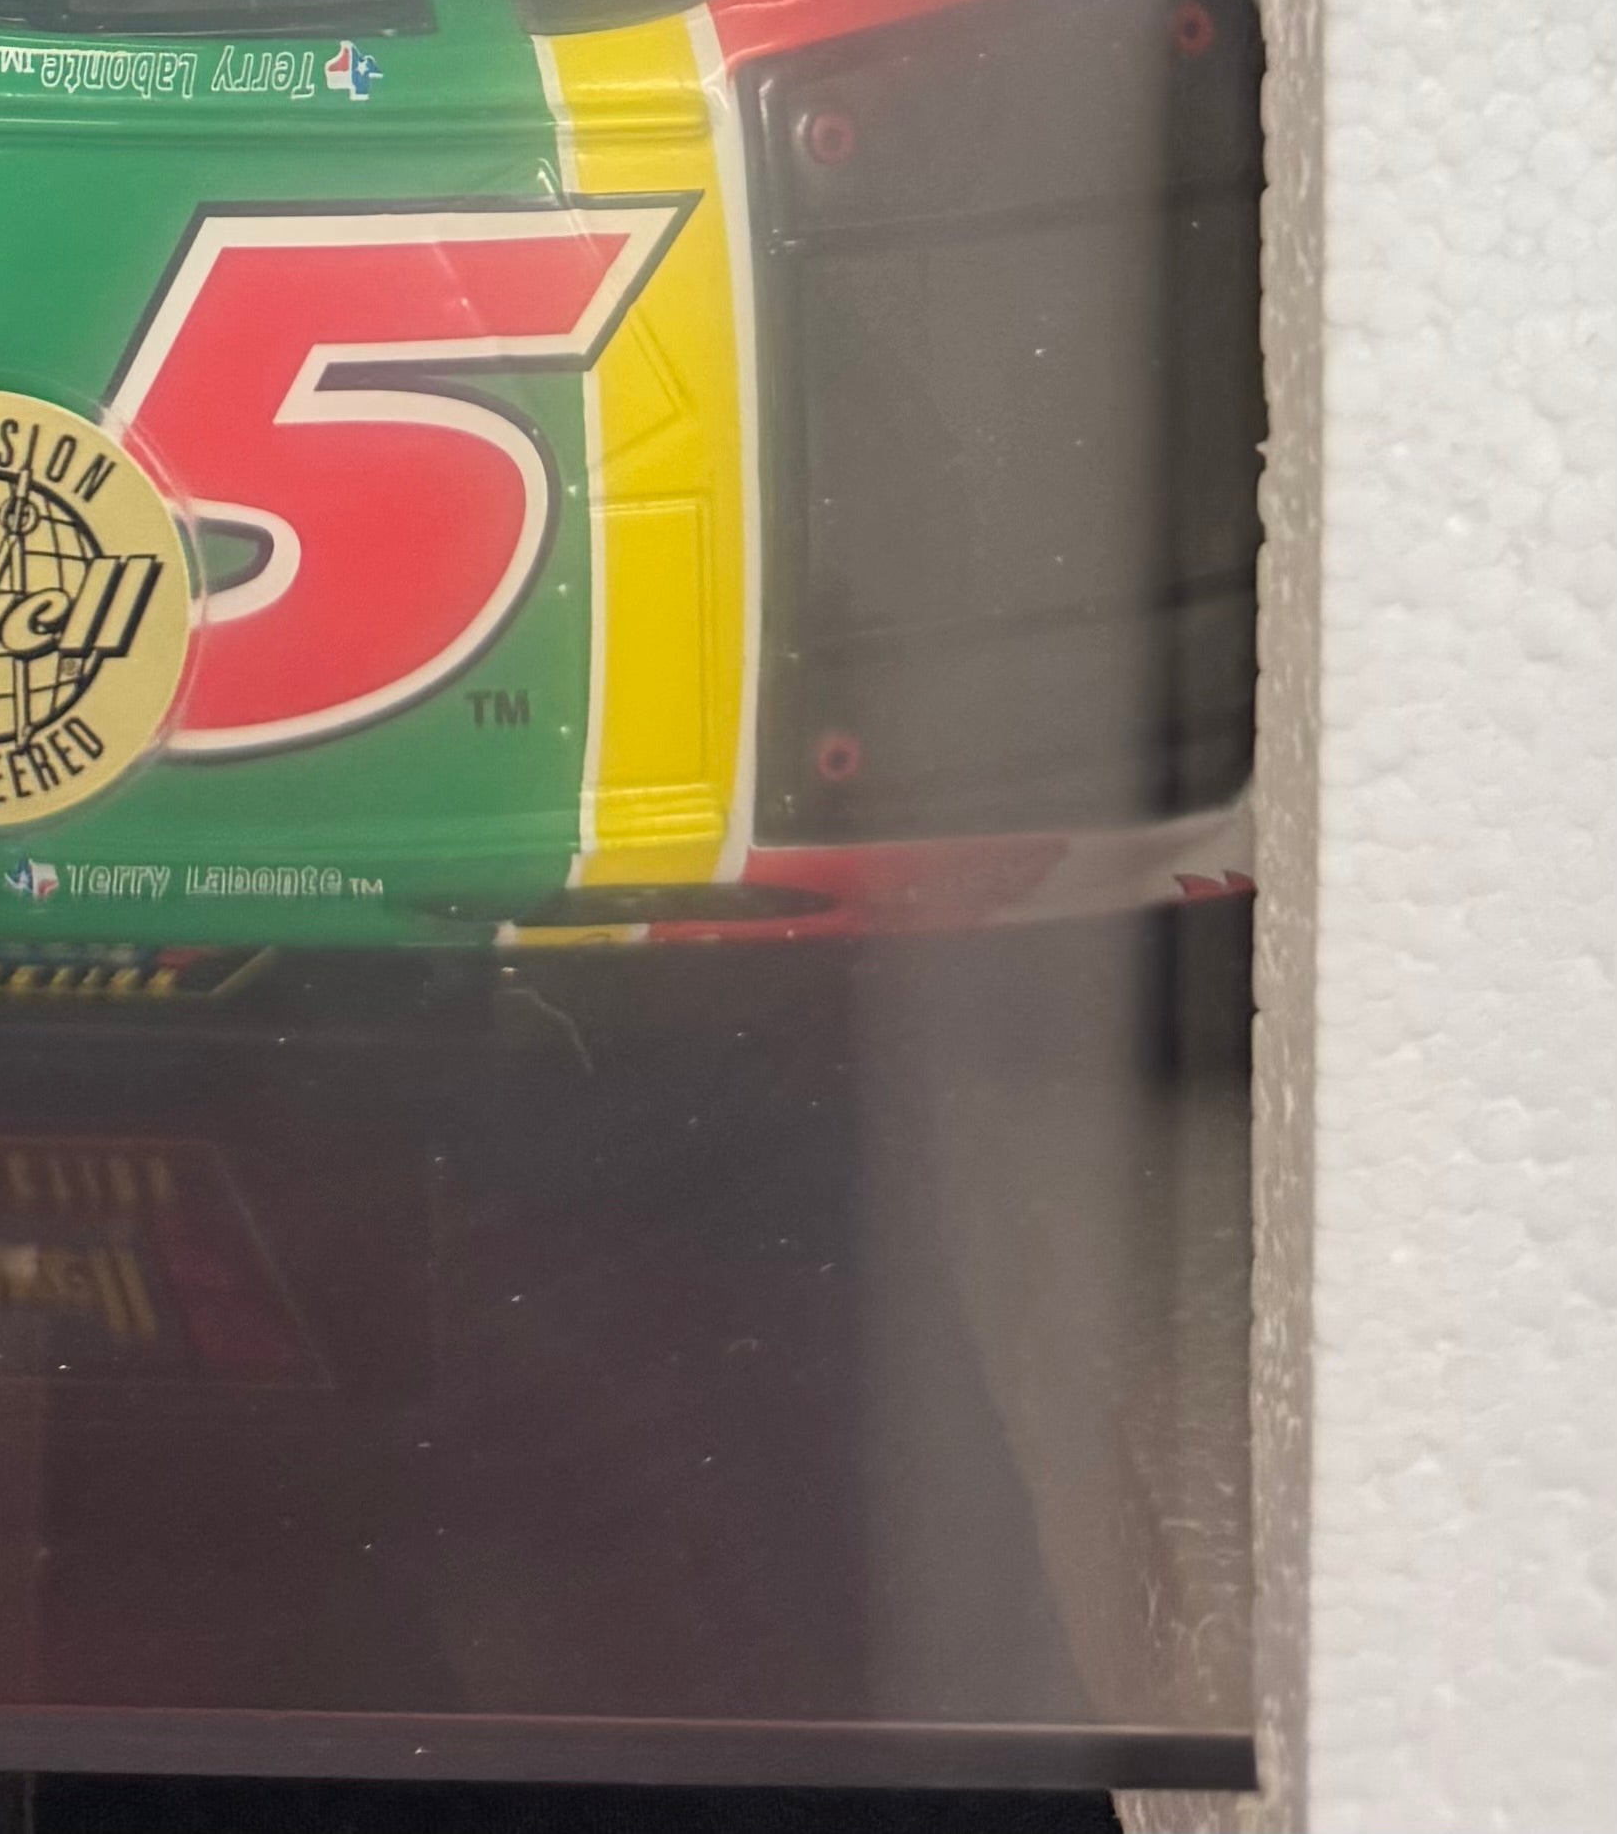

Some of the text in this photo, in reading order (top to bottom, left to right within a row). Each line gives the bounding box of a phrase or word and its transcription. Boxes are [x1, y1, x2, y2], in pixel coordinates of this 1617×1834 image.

[40, 47, 197, 100] Labonte
[211, 51, 315, 99] Terry
[103, 189, 706, 766] 5
[464, 689, 532, 727] TM
[65, 863, 171, 900] Terry
[185, 863, 343, 896] Labonte
